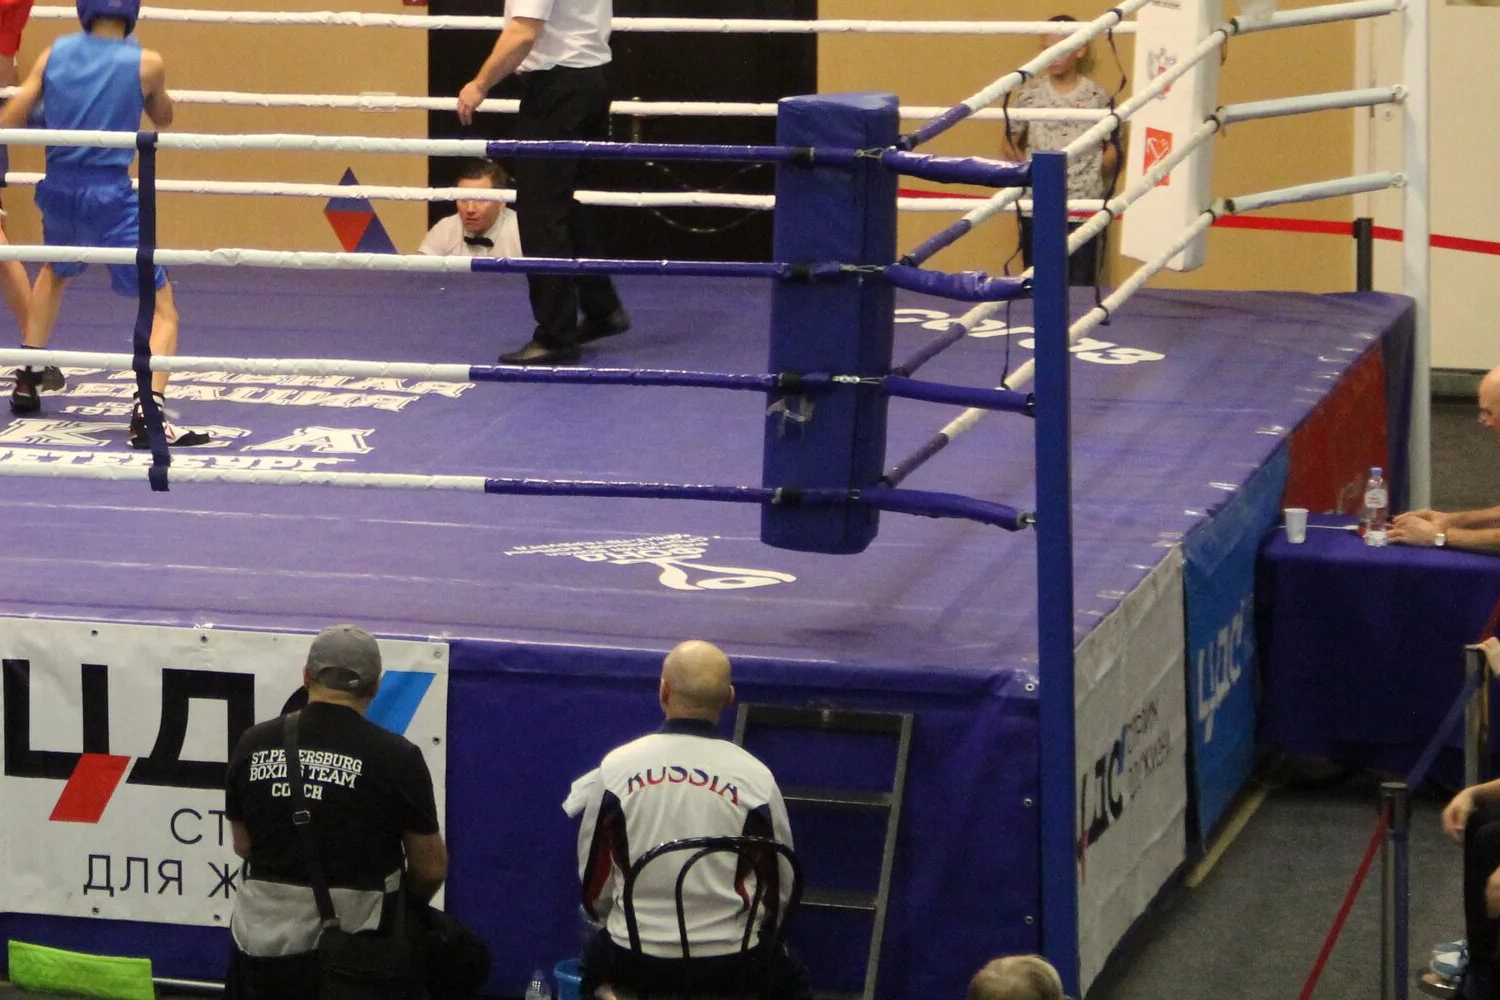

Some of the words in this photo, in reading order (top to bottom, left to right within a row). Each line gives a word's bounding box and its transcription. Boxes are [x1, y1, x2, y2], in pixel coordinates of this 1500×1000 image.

[2, 659, 370, 823] ЦД
[249, 764, 305, 782] BOXI
[309, 764, 357, 788] TEAM
[250, 749, 363, 773] ST.PEERSBURG
[271, 782, 324, 800] COCH
[628, 766, 740, 806] RUSSIA
[83, 854, 184, 897] ДЛЯ
